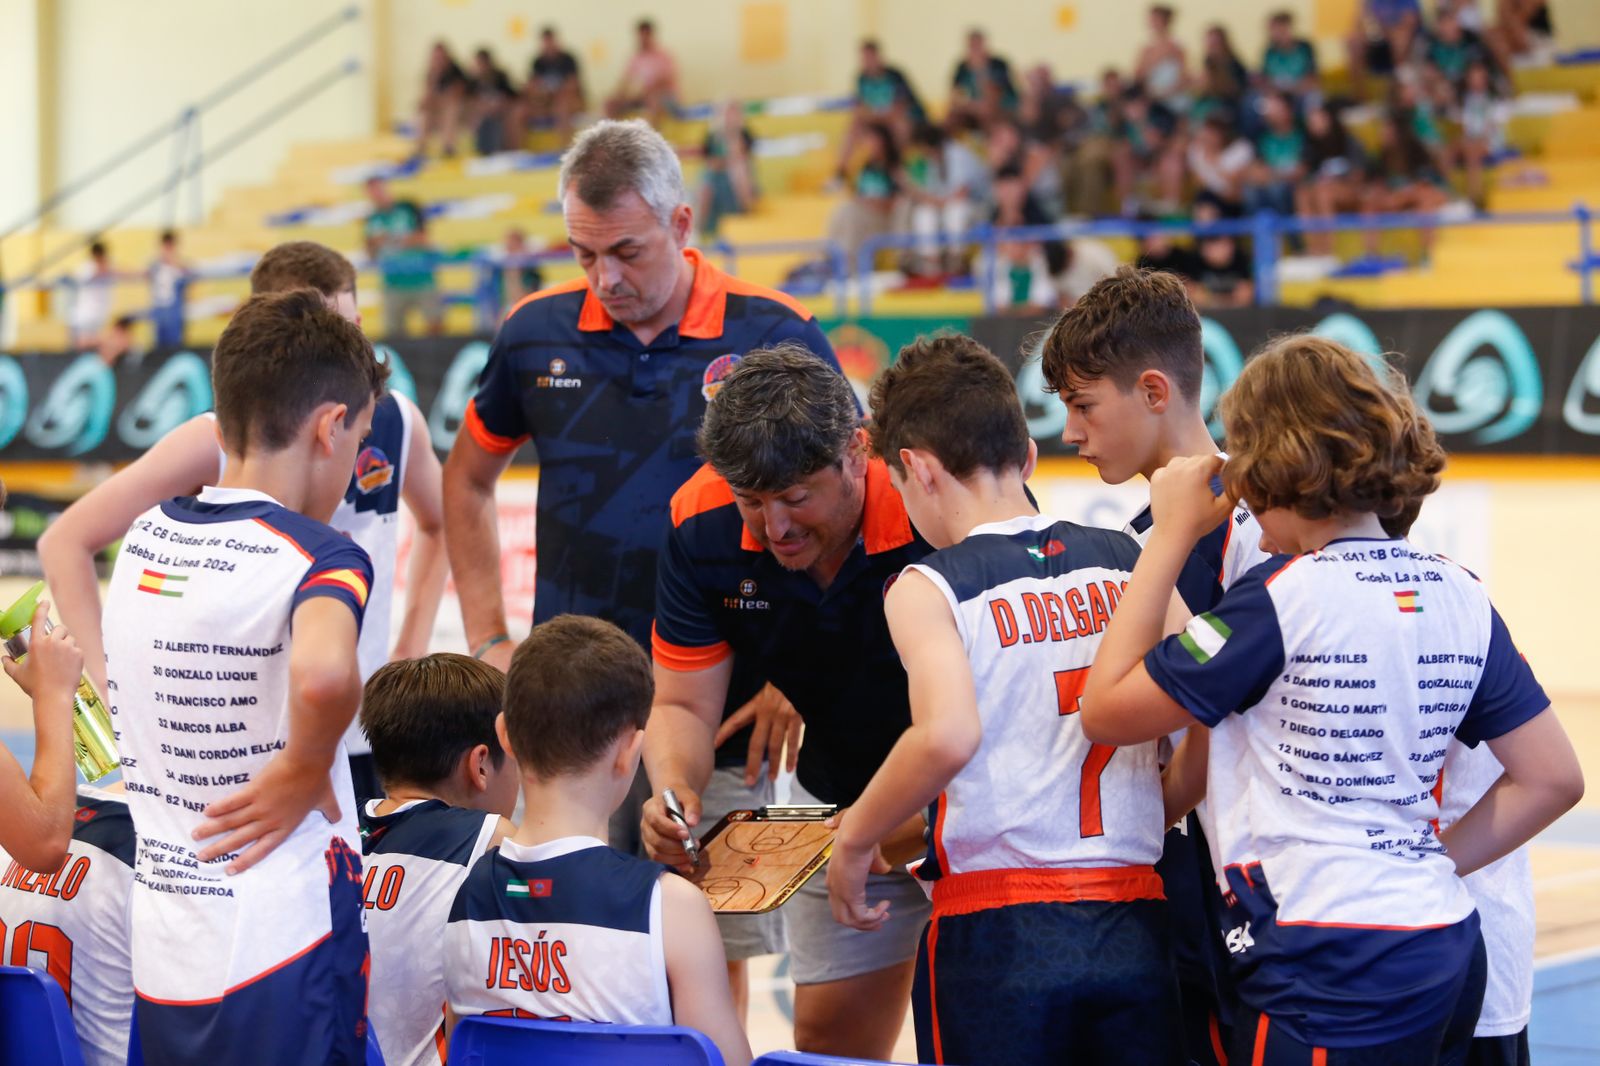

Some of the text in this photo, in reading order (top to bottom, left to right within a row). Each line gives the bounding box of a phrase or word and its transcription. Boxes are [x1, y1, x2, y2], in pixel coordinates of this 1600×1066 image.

[1235, 511, 1250, 526] Mini
[153, 527, 169, 539] CB
[170, 532, 206, 546] Ciudad
[207, 537, 221, 547] de
[225, 538, 279, 554] Córdoba
[126, 543, 155, 561] adeba
[157, 553, 170, 565] La
[203, 558, 236, 572] 2024
[1369, 549, 1387, 560] CB
[1395, 572, 1410, 583] La
[989, 580, 1128, 648] D.DELGAD
[153, 639, 283, 657] 23 ALBERTO FERNÁNDEZ
[1295, 654, 1331, 664] MANU
[1334, 654, 1368, 664] SILES
[1418, 654, 1455, 665] ALBERT
[153, 665, 258, 681] 30 GONZALO LUQUE
[1292, 676, 1330, 688] DARÍO
[1334, 680, 1376, 689] RAMOS
[155, 691, 258, 707] 31 FRANCISCO AMO
[1290, 699, 1350, 714] GONZALO
[158, 717, 247, 733] 32 MARCOS ALBA
[1280, 719, 1384, 739] 7 DIEGO DELGADO
[161, 743, 172, 754] 33
[174, 747, 196, 759] DANI
[199, 747, 247, 760] CORDÓN
[1278, 743, 1384, 763] 12 HUGO SÁNCHEZ
[1409, 753, 1421, 761] 33
[178, 772, 209, 786] JESÚS
[212, 774, 250, 786] LÓPEZ
[1336, 774, 1396, 787] DOMÍNGUEZ
[166, 795, 180, 806] 82
[175, 886, 235, 898] FIGUEROA
[486, 930, 571, 994] JESÚS
